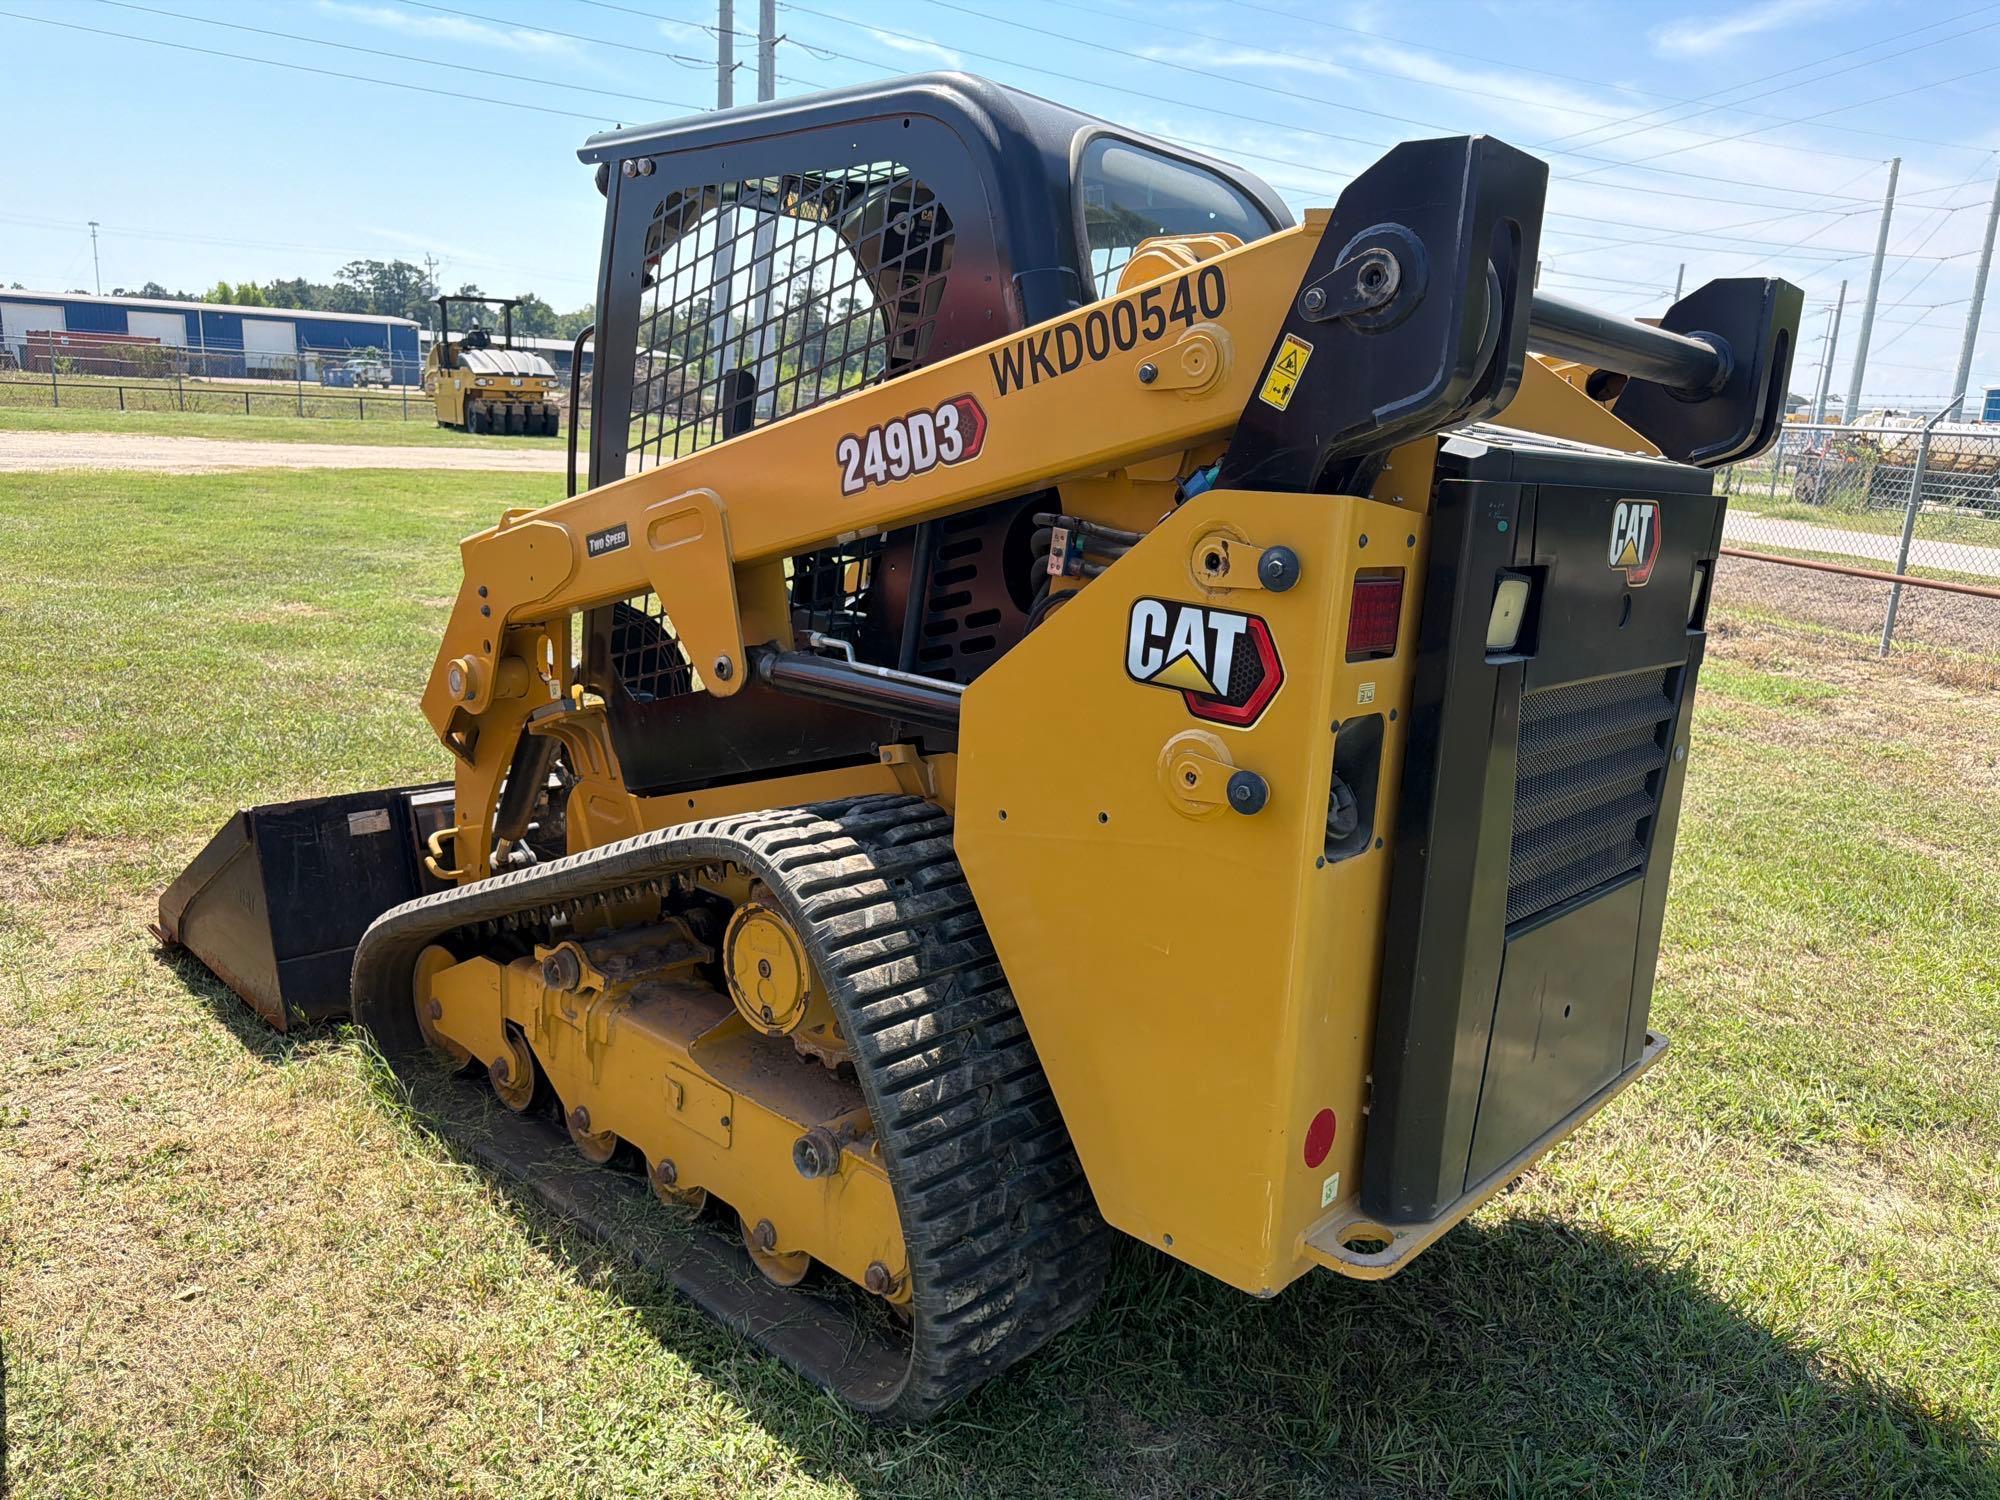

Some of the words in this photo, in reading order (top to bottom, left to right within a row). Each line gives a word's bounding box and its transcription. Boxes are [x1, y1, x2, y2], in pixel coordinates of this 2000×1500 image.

[988, 265, 1226, 397] WKD00540
[838, 404, 963, 492] 249D3
[1610, 503, 1653, 566] CAT
[1128, 599, 1247, 697] CAT
